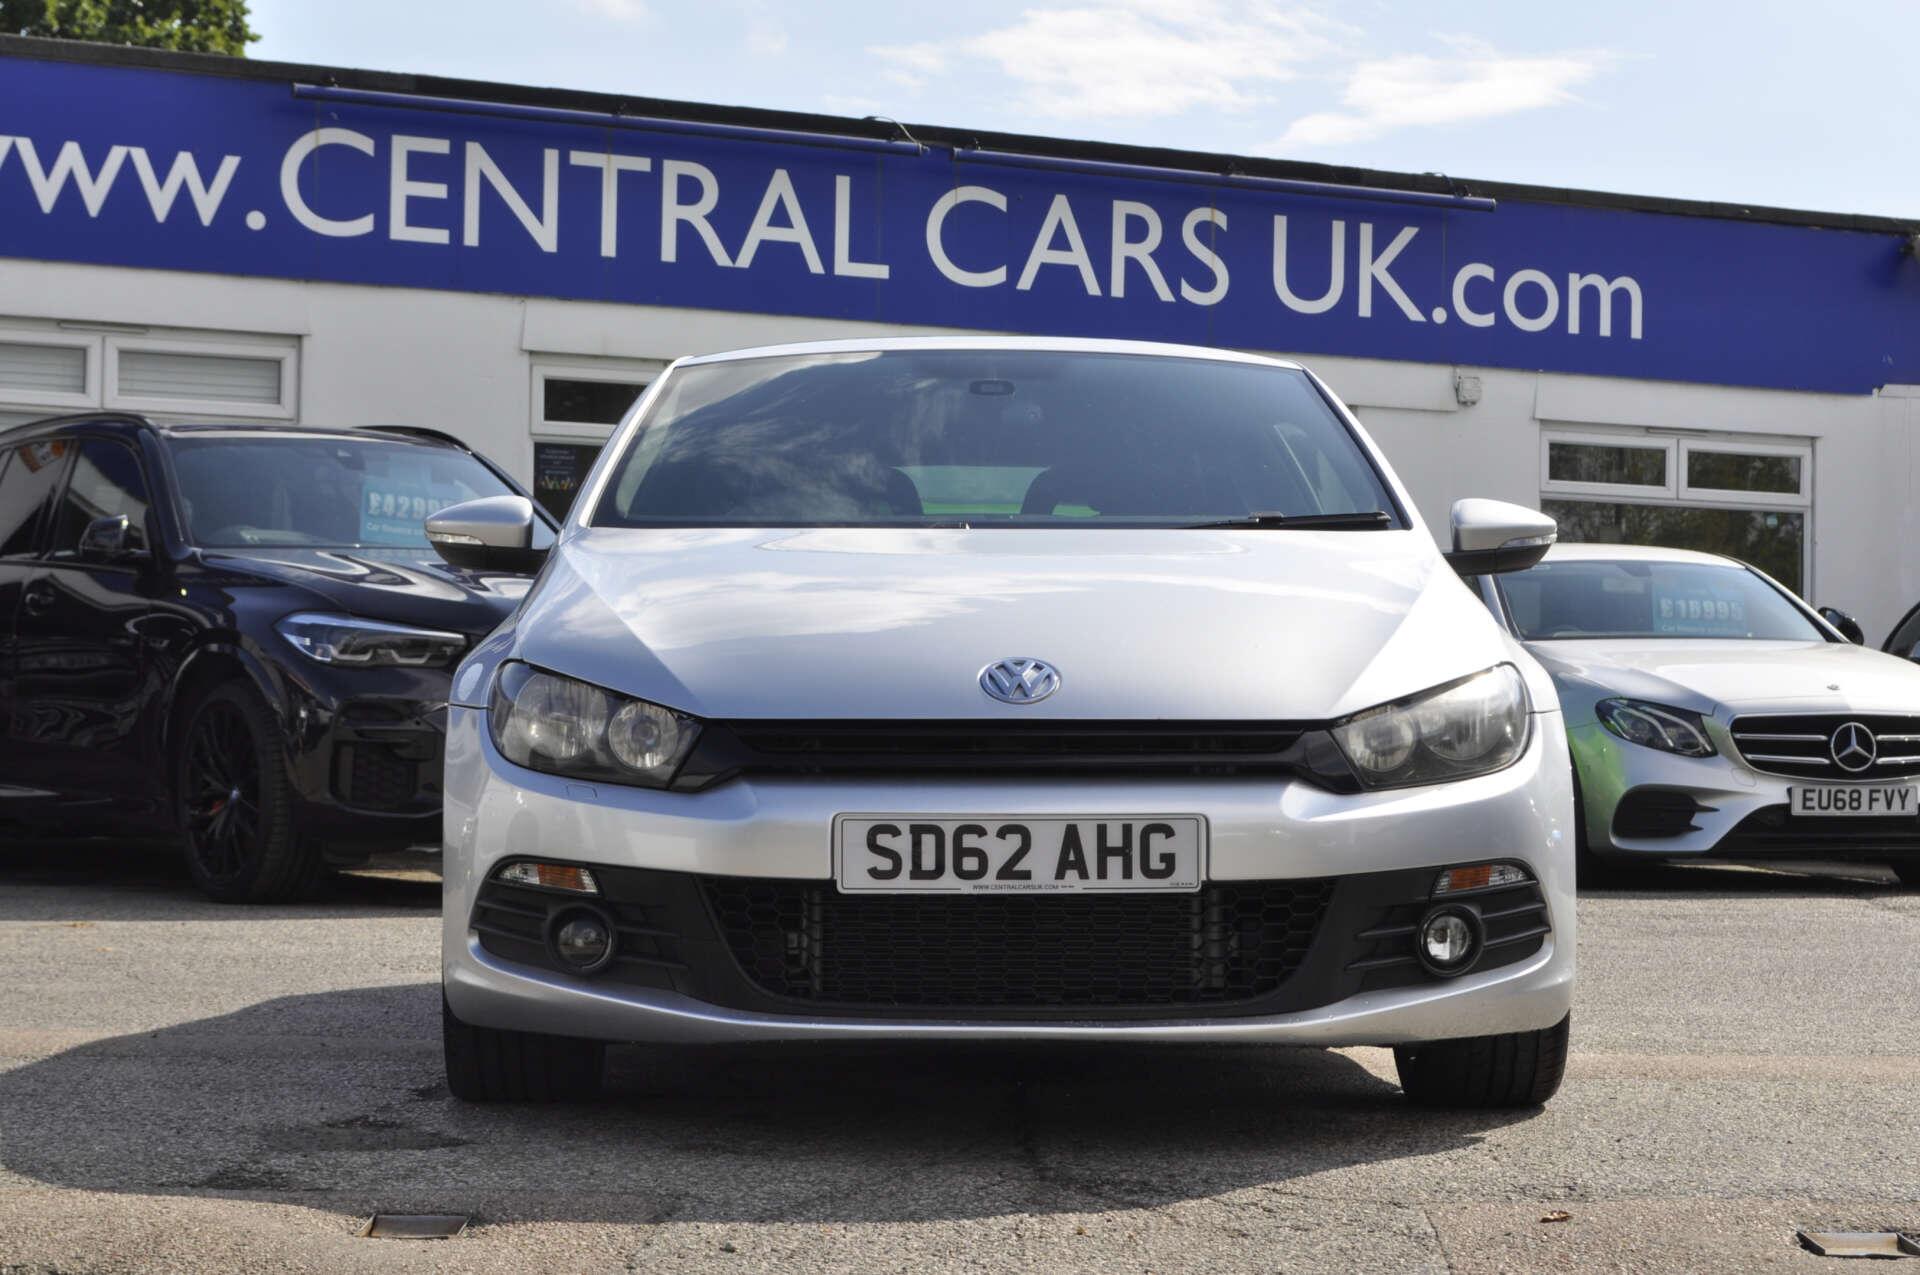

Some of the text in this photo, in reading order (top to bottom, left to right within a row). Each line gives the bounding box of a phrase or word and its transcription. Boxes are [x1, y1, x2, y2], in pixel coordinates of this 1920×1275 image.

[926, 185, 1230, 306] CARS
[1272, 214, 1643, 340] UK.com
[1802, 788, 1910, 811] EU68 FVY
[866, 823, 1177, 881] SD62 AHG
